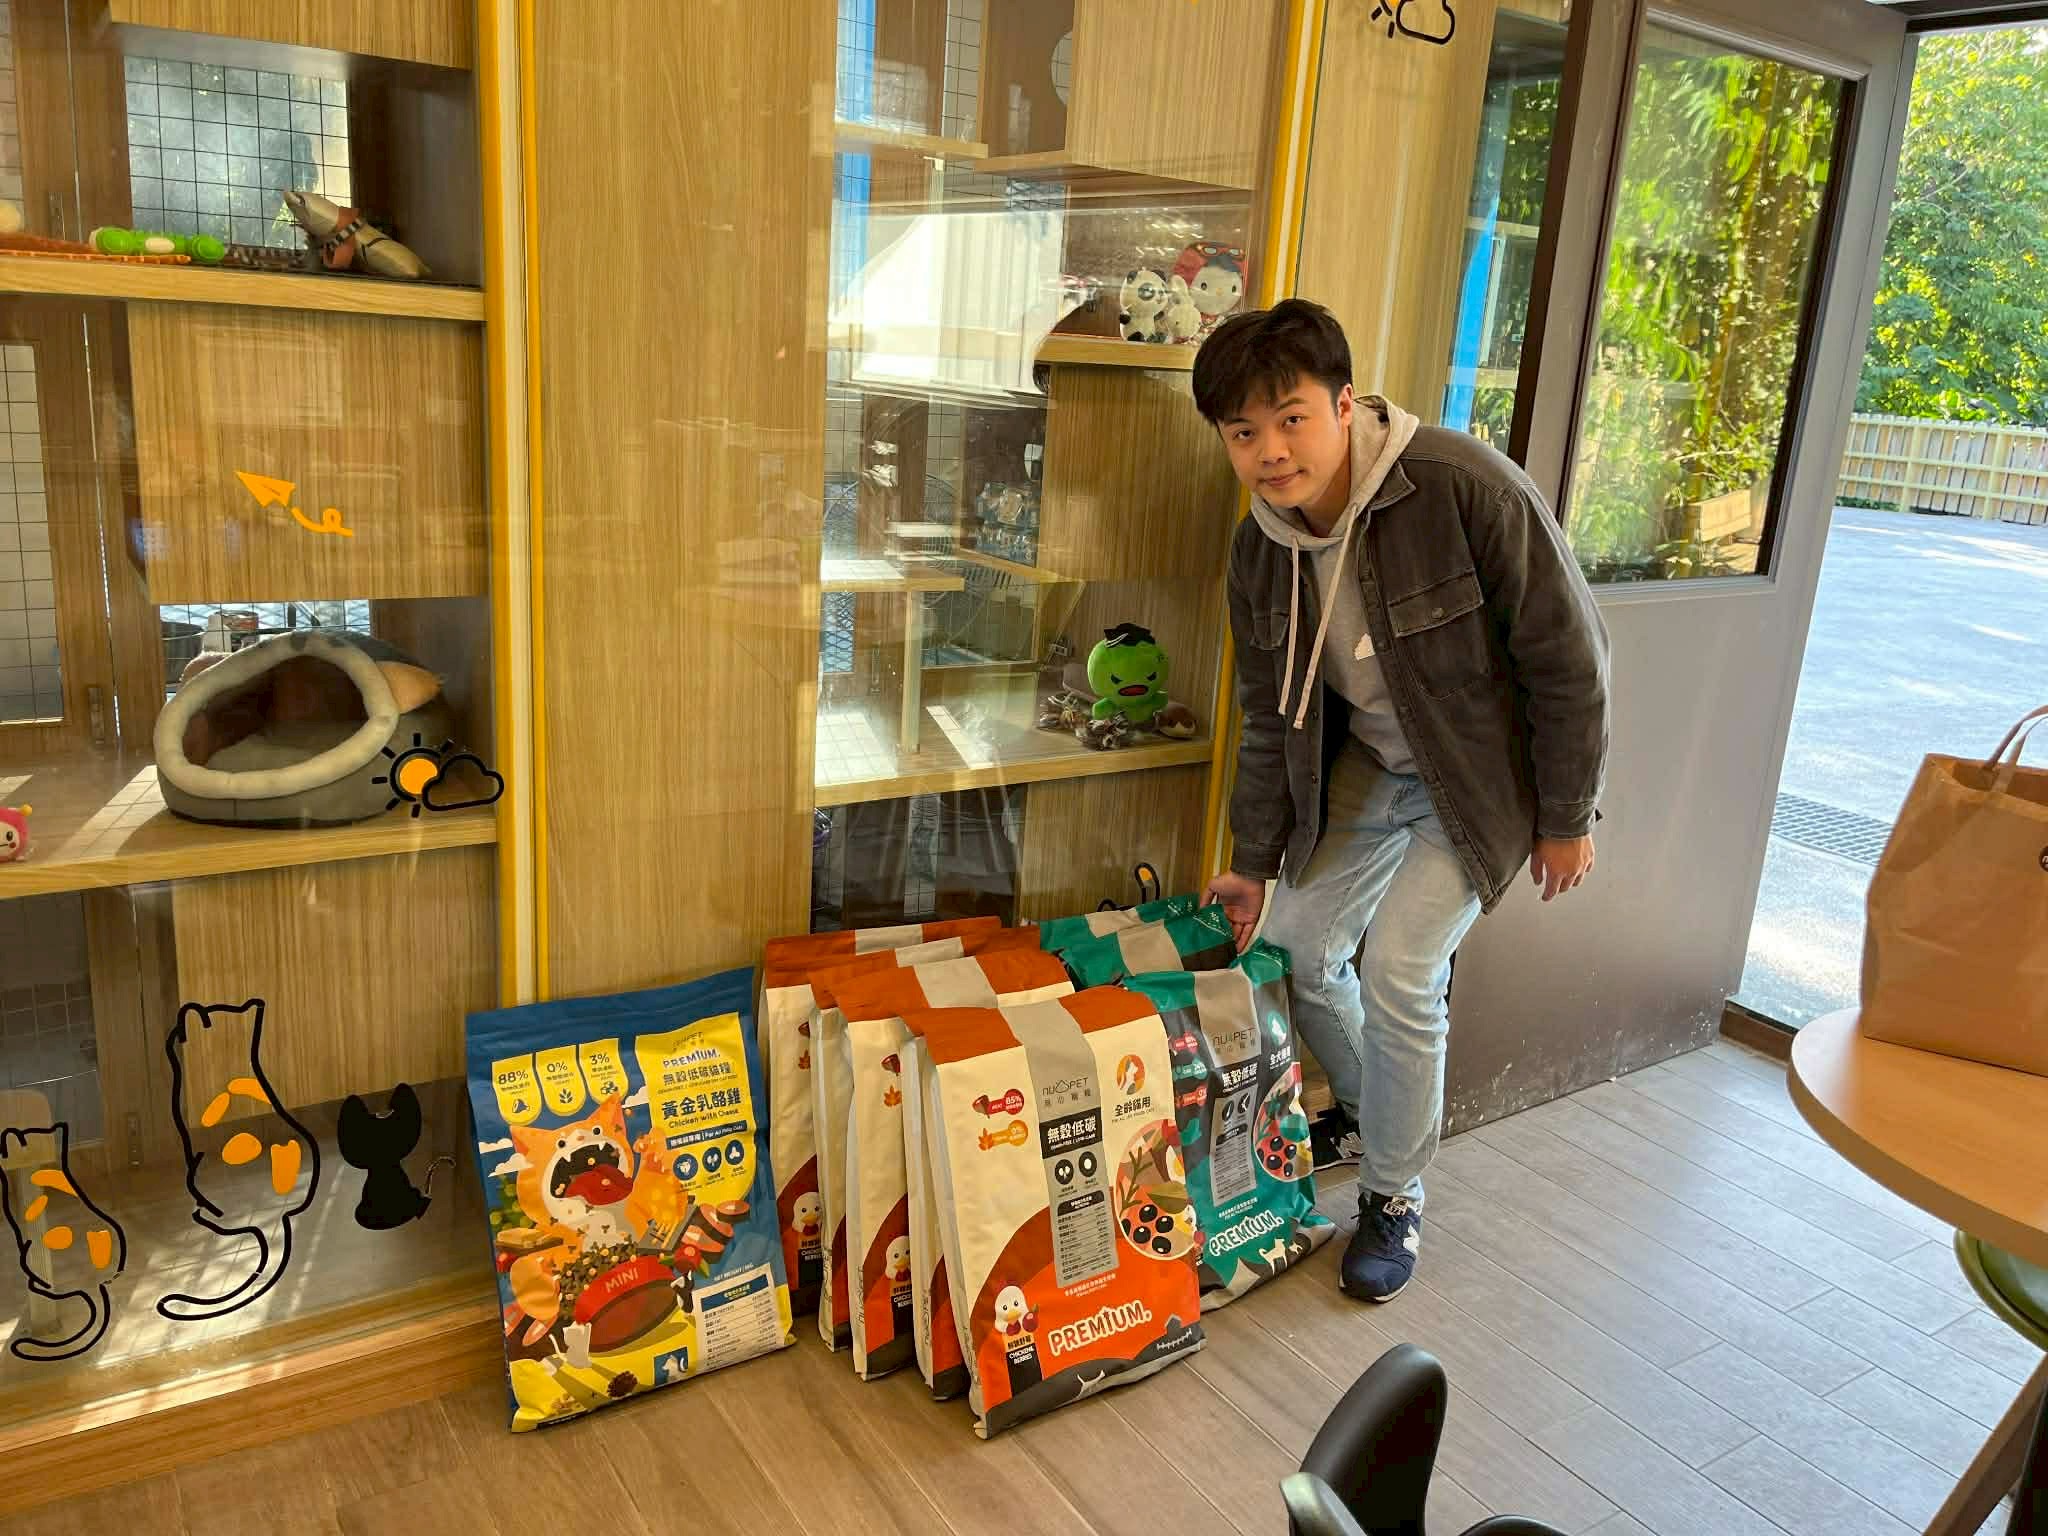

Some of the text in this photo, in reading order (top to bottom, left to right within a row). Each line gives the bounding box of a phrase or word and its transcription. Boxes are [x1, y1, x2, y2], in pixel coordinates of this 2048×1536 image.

[547, 1062, 568, 1073] 0%
[590, 1053, 610, 1065] 3%
[498, 1069, 529, 1085] 88%
[662, 1087, 741, 1120] 黃金乳酪雞
[669, 1117, 699, 1129] Chicken
[701, 1112, 717, 1122] with
[1048, 1115, 1097, 1144] 無穀低碳
[1209, 1209, 1285, 1256] PREMIUM.
[605, 1267, 639, 1293] MINI
[1048, 1300, 1152, 1357] PREMIUM.
